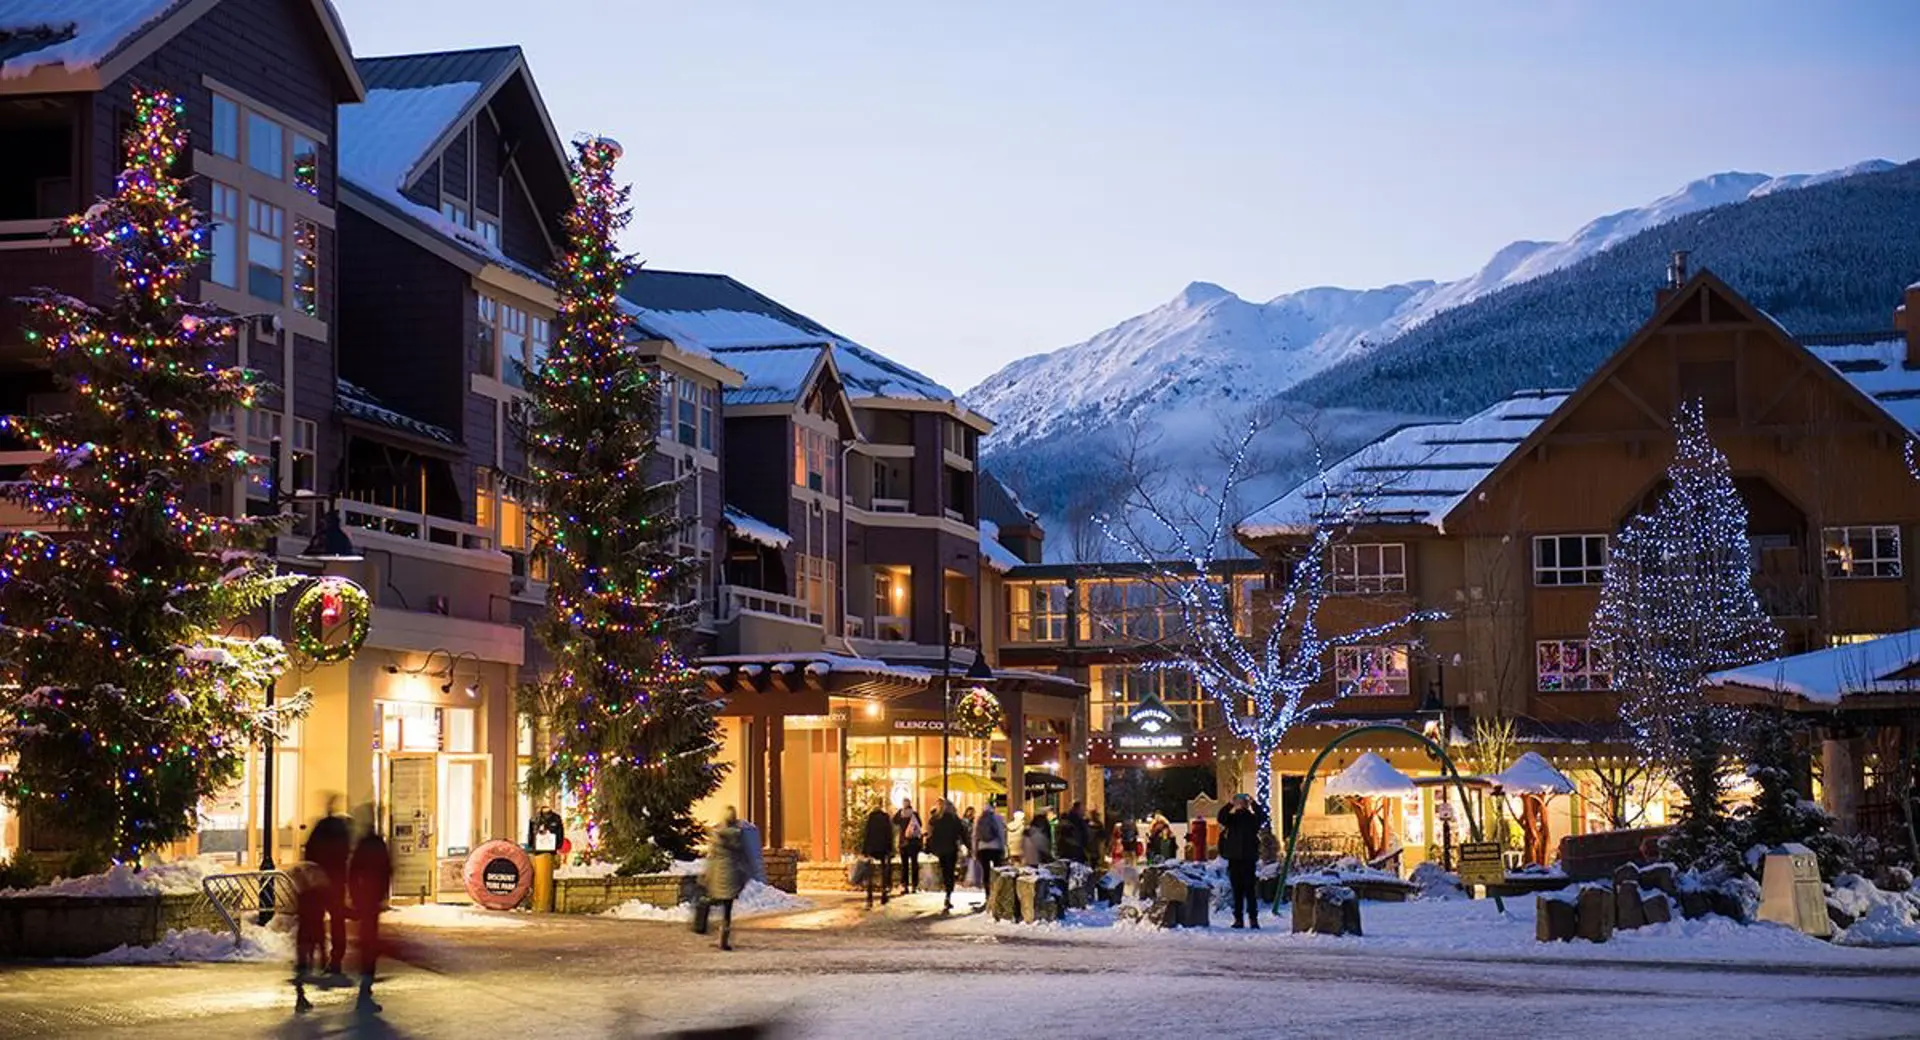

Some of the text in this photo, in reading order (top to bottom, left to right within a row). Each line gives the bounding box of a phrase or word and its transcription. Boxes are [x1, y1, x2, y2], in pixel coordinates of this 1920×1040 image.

[1131, 709, 1172, 723] WHISTLER'S
[894, 720, 927, 729] BLENZ
[487, 873, 516, 881] DISCOUNT
